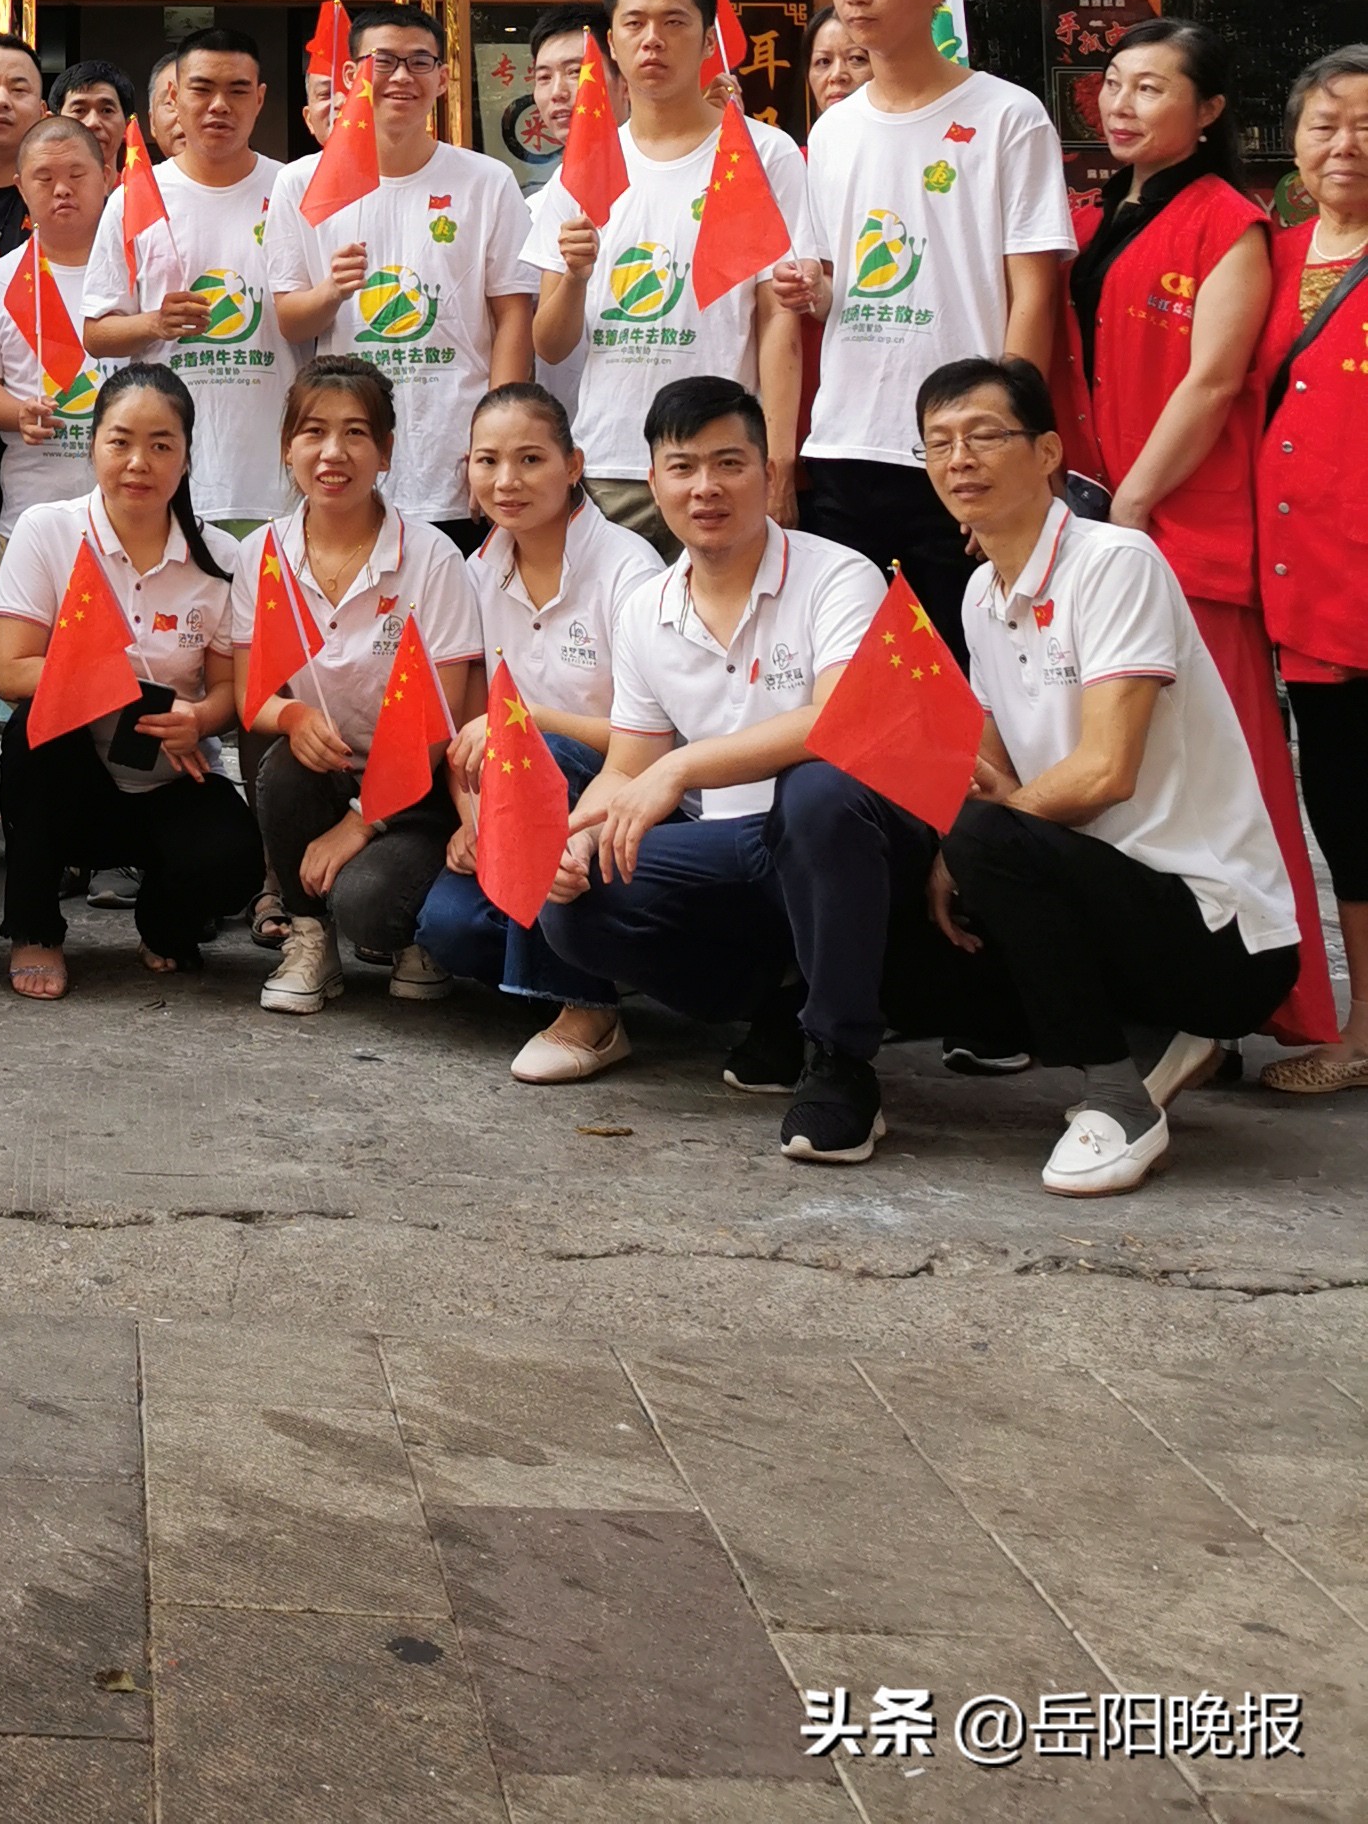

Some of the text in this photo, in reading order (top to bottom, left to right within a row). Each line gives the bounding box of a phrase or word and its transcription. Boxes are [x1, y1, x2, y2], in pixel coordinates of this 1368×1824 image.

[169, 349, 276, 370] 牵着蜗牛去散步
